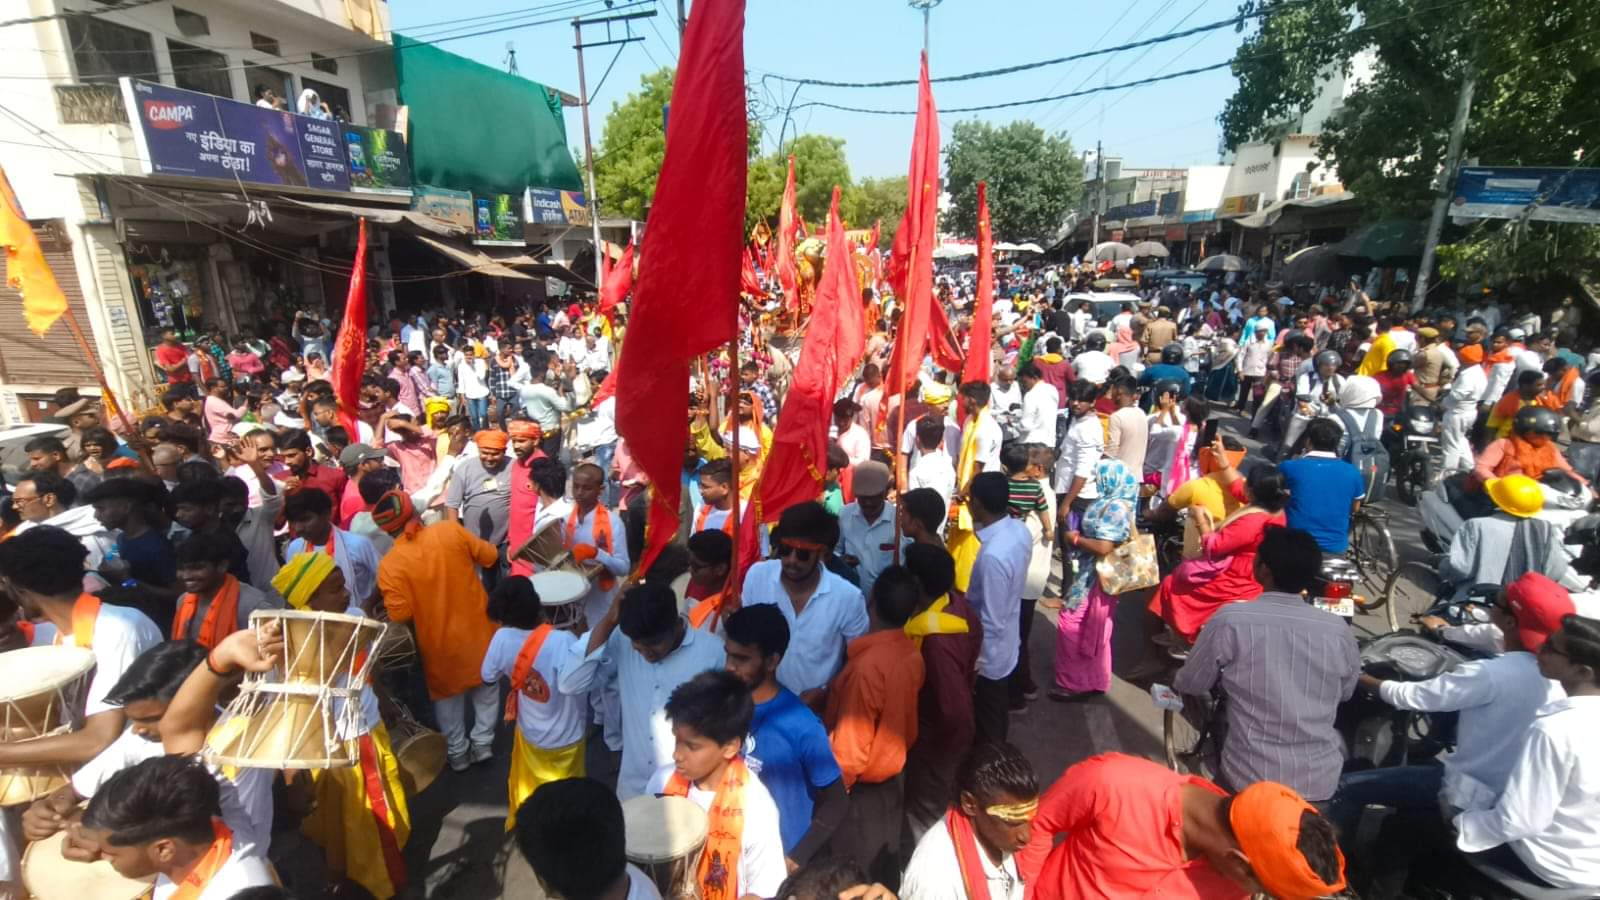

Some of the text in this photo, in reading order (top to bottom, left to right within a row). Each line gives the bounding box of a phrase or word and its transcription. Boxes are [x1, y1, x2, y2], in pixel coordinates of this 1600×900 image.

[150, 105, 193, 122] CAMPA
[200, 131, 237, 153] इंडिया
[239, 140, 256, 155] का
[304, 133, 336, 147] GENERAL
[311, 145, 334, 156] STORE
